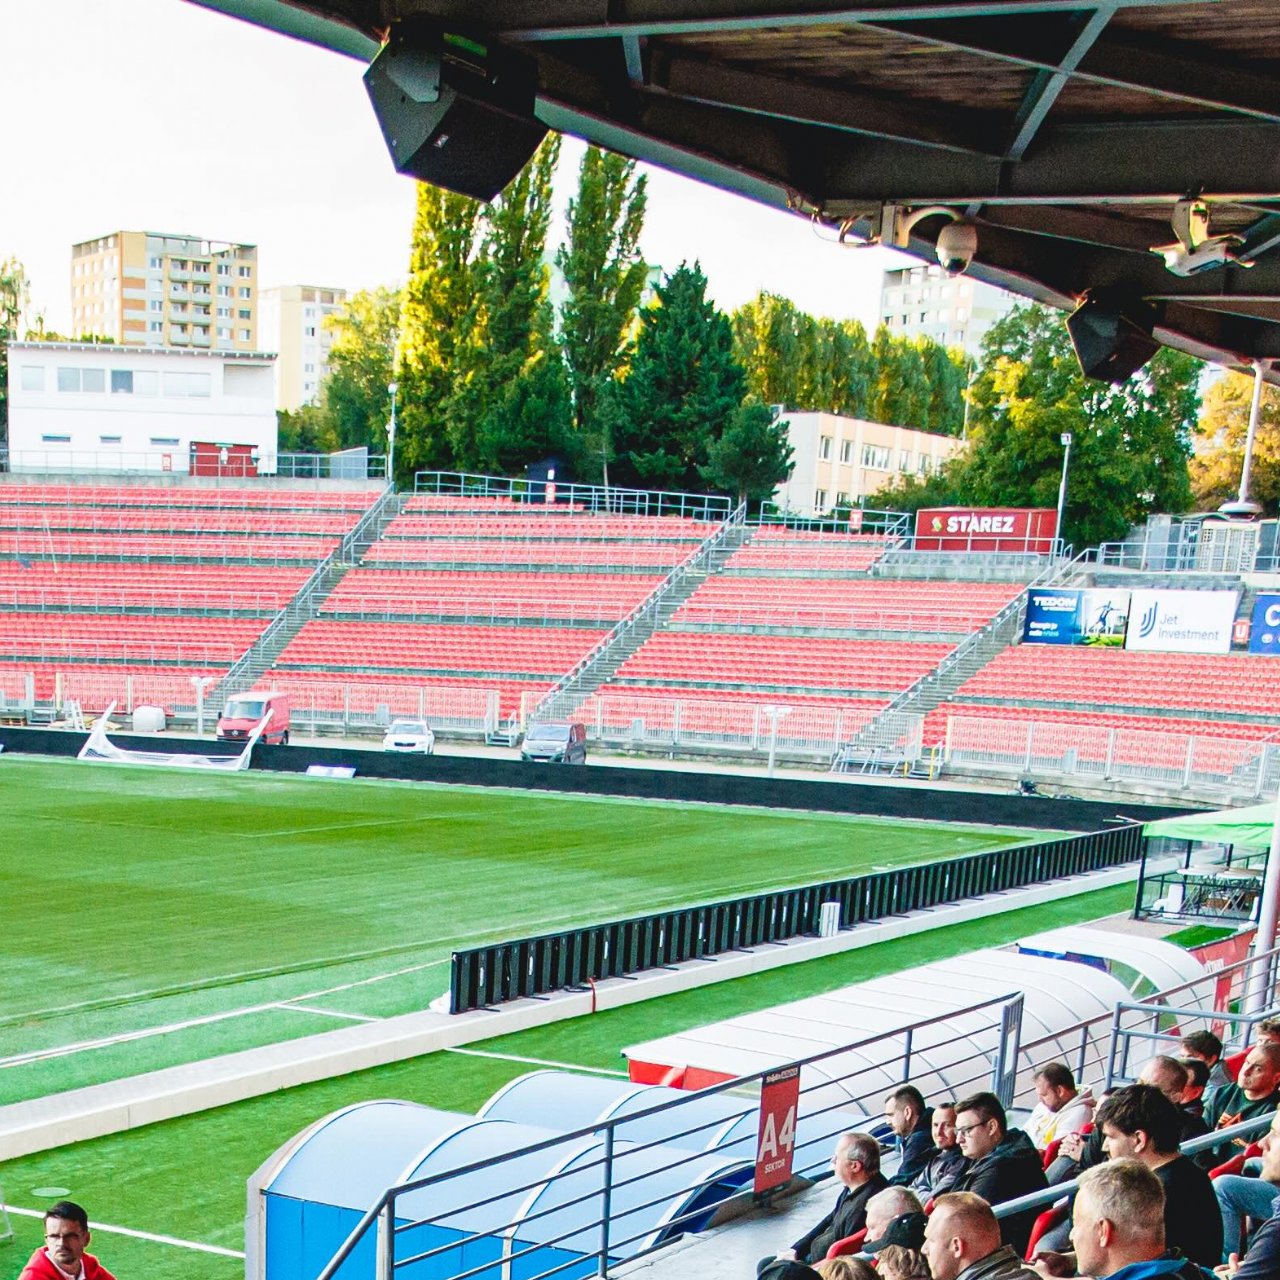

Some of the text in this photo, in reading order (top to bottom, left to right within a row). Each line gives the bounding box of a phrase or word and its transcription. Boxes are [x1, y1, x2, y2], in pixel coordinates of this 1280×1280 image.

[946, 516, 1015, 533] STAREZ
[1160, 614, 1178, 626] Jet
[758, 1105, 795, 1163] A4
[764, 1158, 786, 1174] SEKTOR
